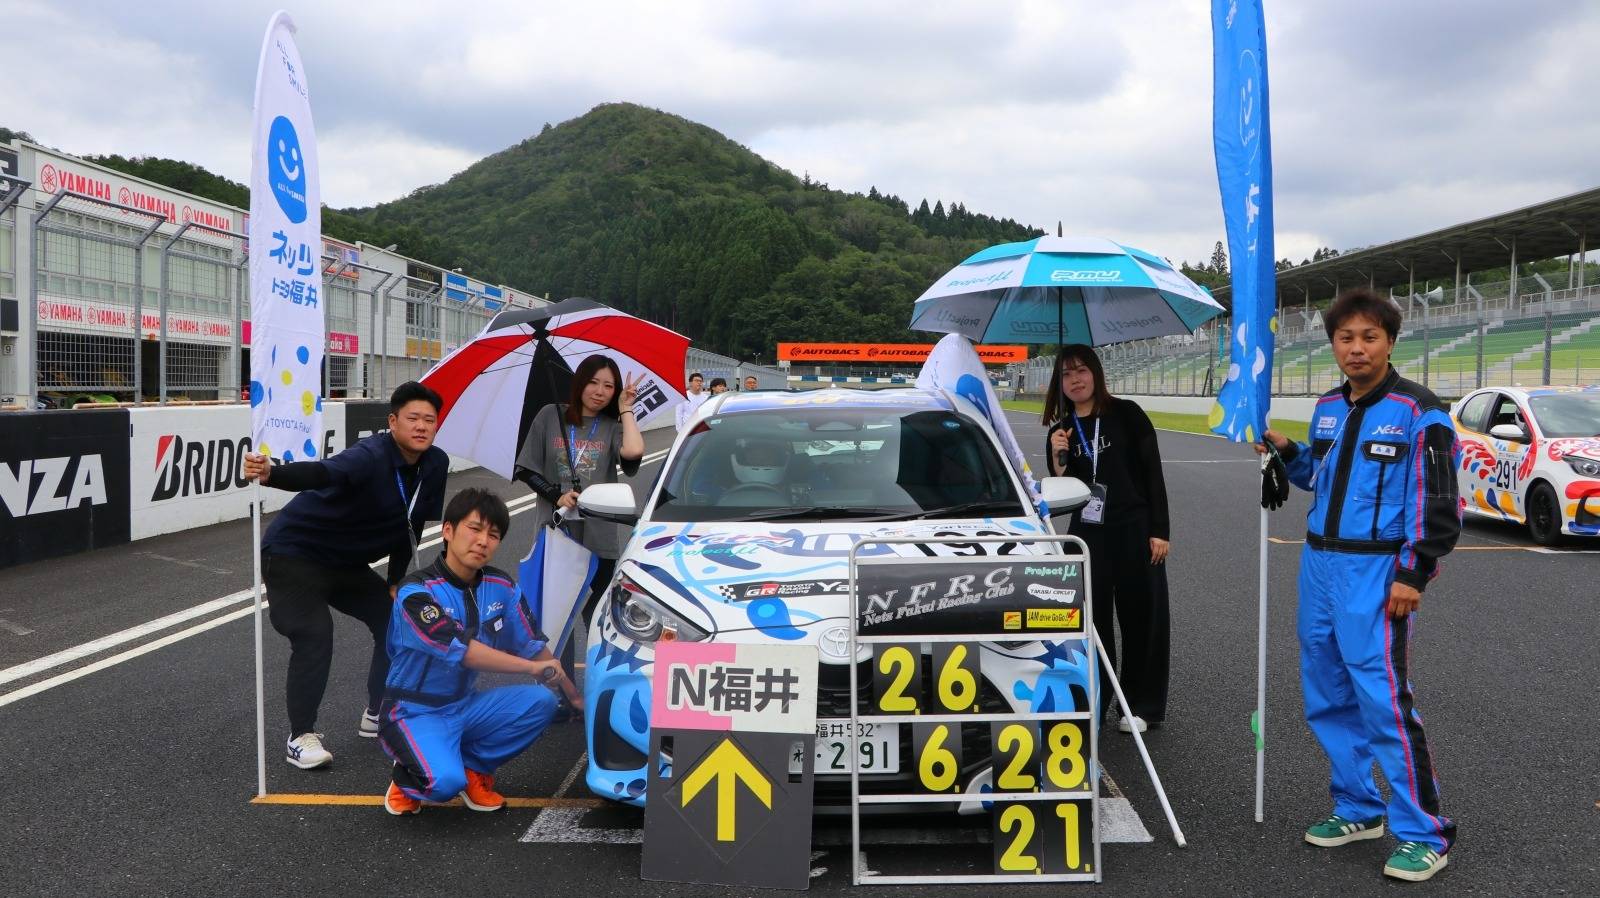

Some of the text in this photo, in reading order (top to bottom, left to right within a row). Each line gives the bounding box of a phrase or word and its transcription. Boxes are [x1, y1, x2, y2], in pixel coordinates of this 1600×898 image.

[59, 170, 232, 239] YAMAHA YAMAHA YAMAHA
[269, 229, 314, 276] ネッツ
[50, 304, 231, 337] YAMAHA YAMAHA AMAH YAMAHA YAMAHA
[802, 348, 861, 356] AUTOBACS
[880, 349, 932, 357] AUTOBAC
[270, 418, 298, 429] TOYOTA
[1496, 459, 1517, 490] 291
[864, 583, 1016, 627] Netz Fukui Racing Club
[1028, 611, 1039, 622] JAM
[1040, 613, 1051, 622] drive
[671, 666, 799, 714] N福井
[815, 722, 874, 738] 福井 532
[918, 724, 958, 792] 6
[999, 803, 1080, 871] 21
